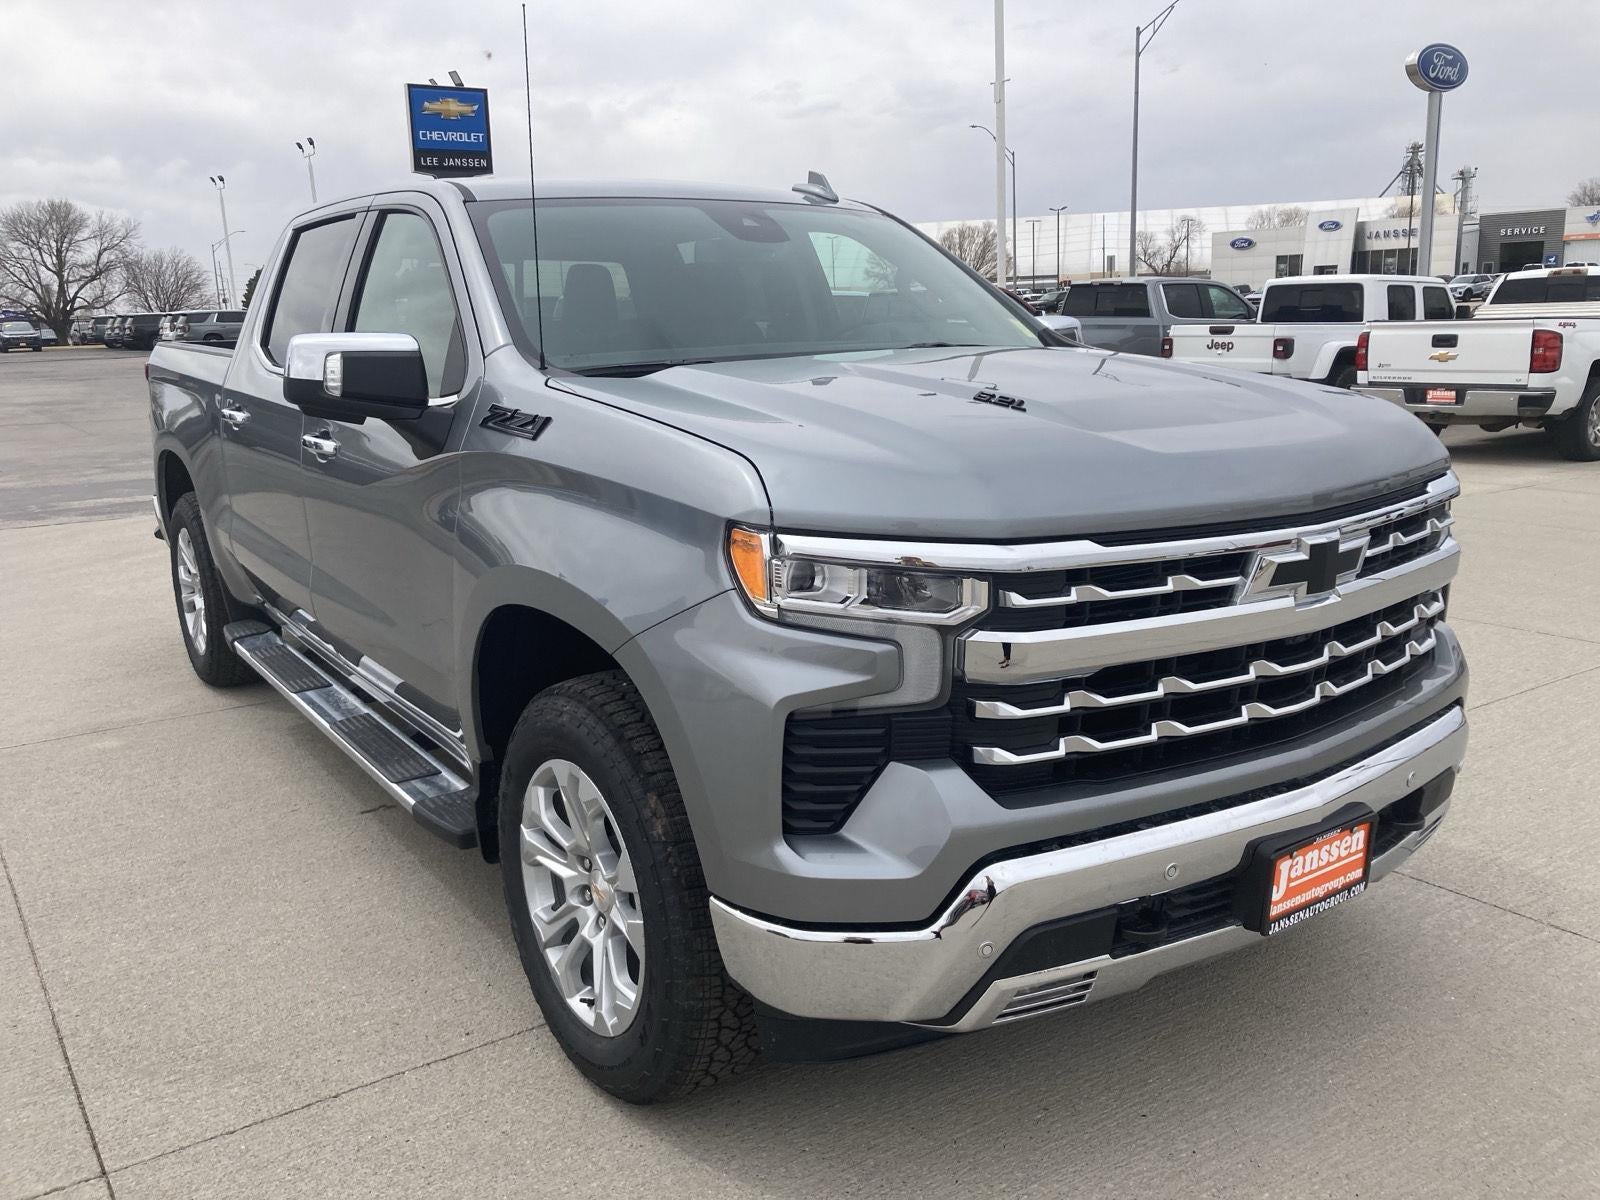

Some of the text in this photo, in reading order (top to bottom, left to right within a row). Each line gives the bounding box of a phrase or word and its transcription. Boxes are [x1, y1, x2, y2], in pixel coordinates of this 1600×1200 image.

[1429, 51, 1461, 81] Ford
[419, 130, 484, 143] CHEVROLET
[420, 157, 487, 167] LEE JANSSEN
[1367, 228, 1418, 239] JANSSE
[1500, 226, 1546, 236] SERVICE
[1206, 338, 1234, 352] Jeep
[479, 403, 553, 441] Z71
[1271, 829, 1366, 902] Janssen
